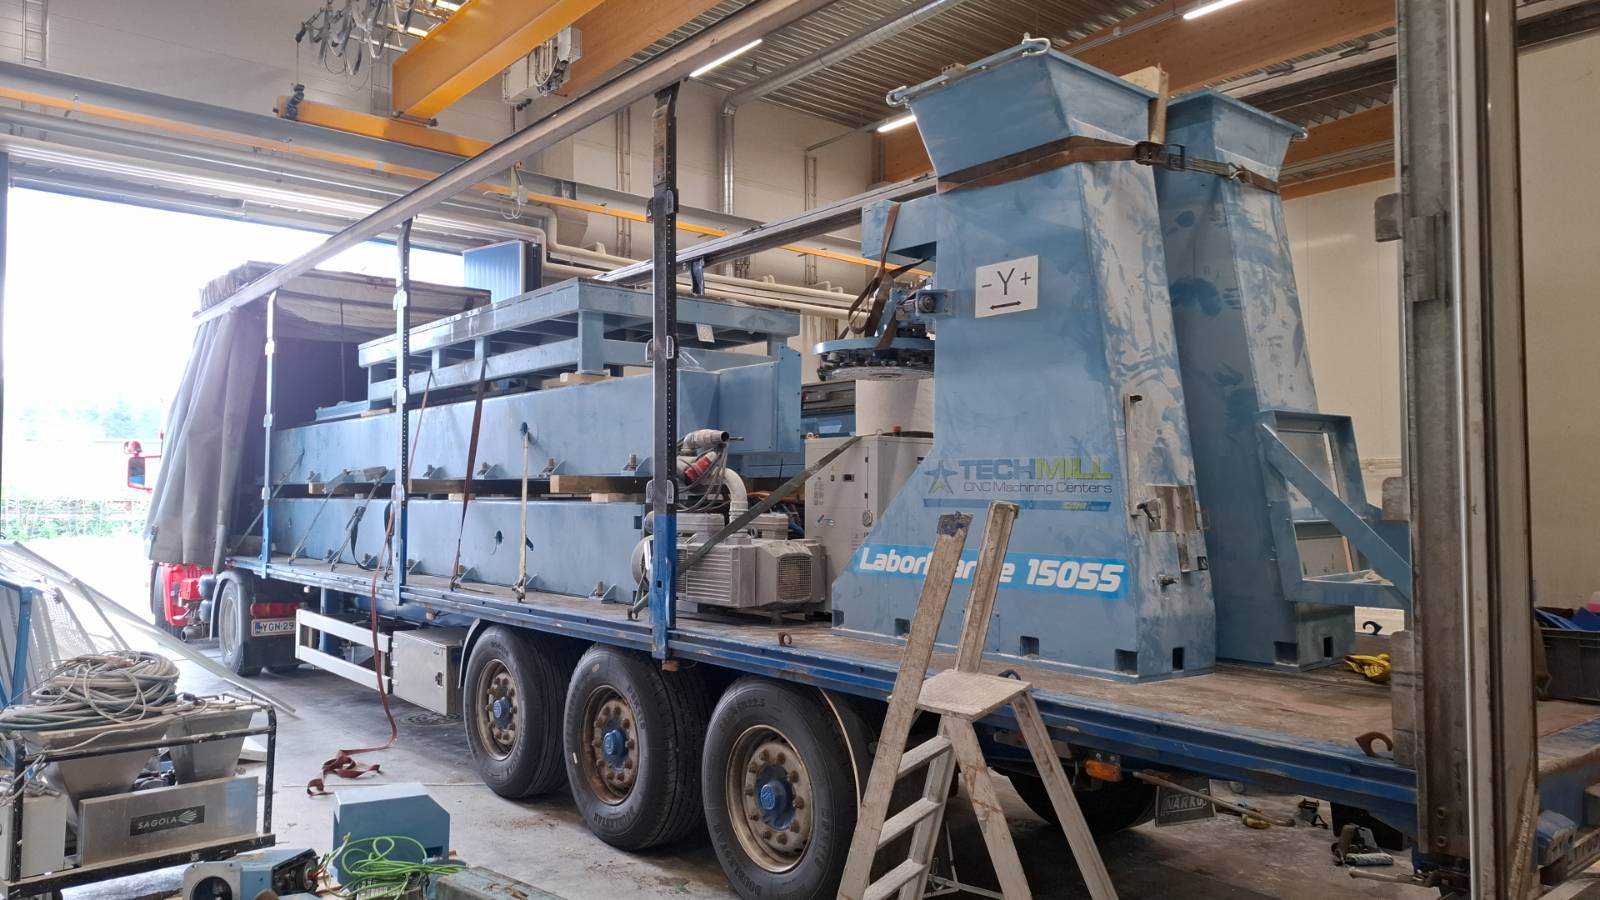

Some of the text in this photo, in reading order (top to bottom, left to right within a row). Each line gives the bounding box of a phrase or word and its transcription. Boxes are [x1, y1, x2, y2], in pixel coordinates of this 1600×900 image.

[959, 456, 1113, 480] TECHMILL
[963, 481, 1113, 494] CNC Machining Centers
[137, 816, 177, 830] SAGOLA
